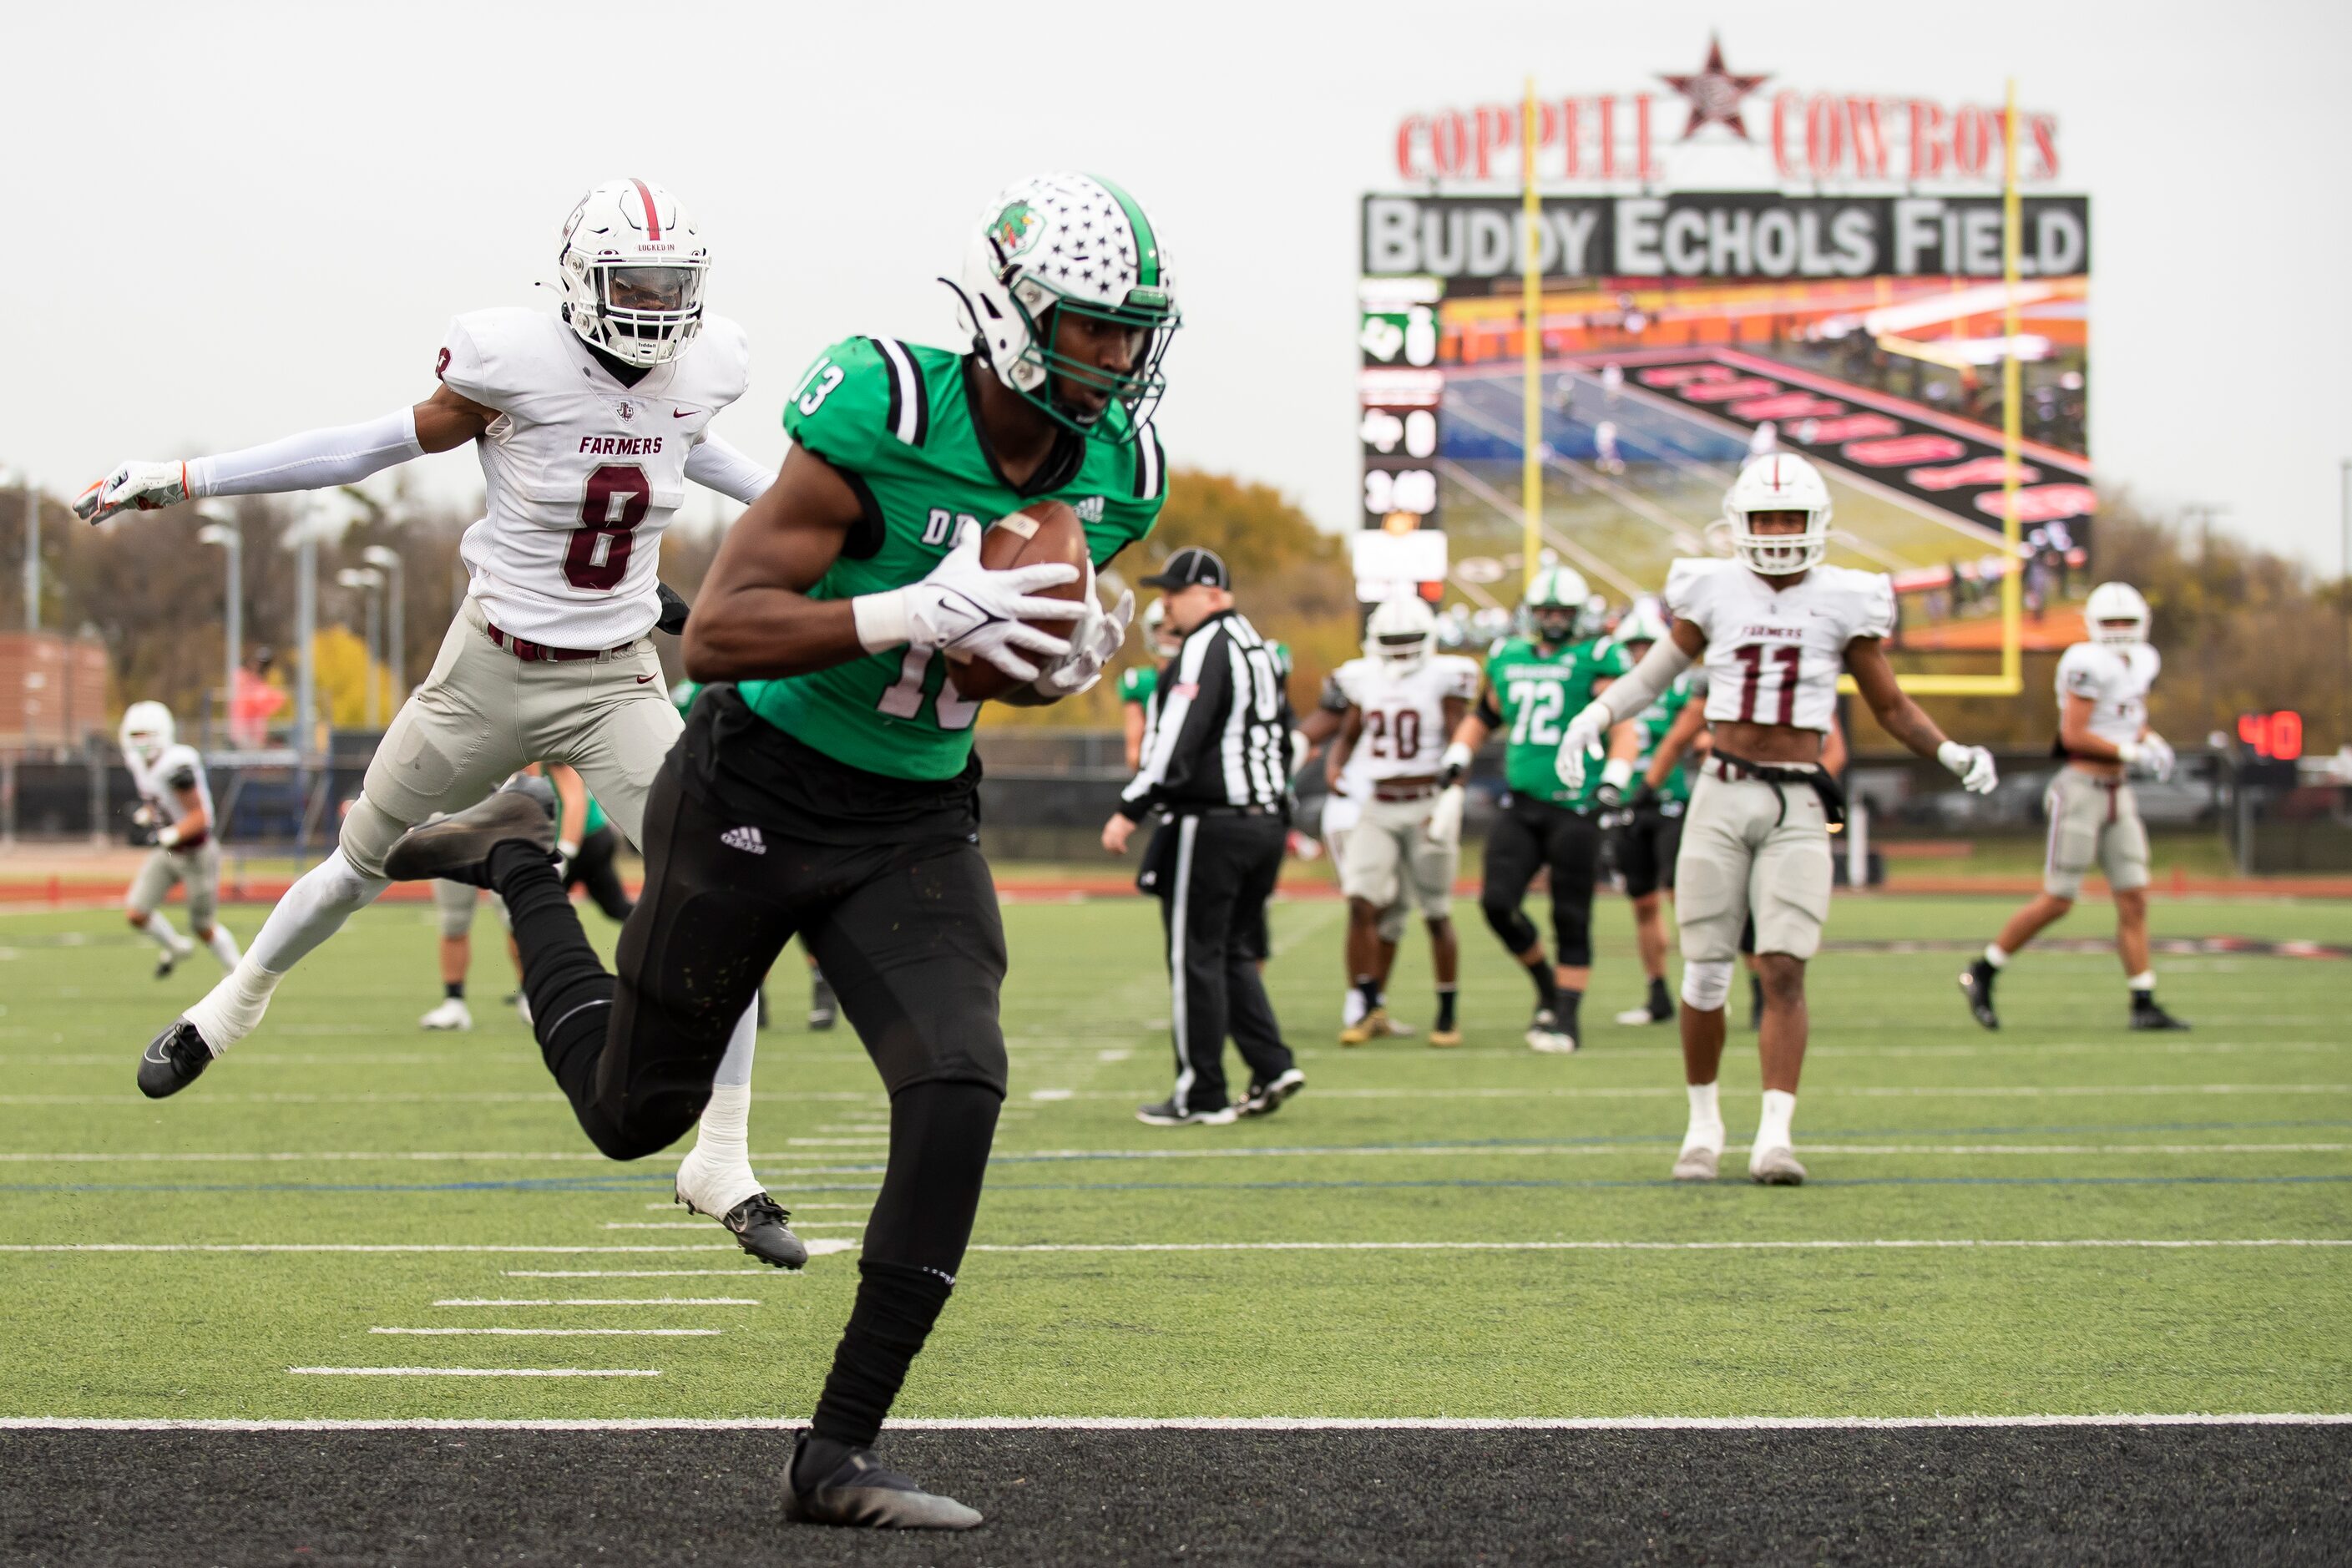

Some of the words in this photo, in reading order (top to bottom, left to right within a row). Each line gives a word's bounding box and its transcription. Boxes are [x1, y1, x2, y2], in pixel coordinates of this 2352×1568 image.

[1396, 93, 1664, 182] COPPELL
[1771, 90, 2060, 182] COWBOYS
[1366, 200, 1598, 277] BUDDY
[1615, 199, 1875, 277] ECHOLS
[1895, 200, 2085, 275] FIELD
[790, 356, 845, 417] 13
[579, 437, 663, 455] FARMERS
[559, 462, 654, 595] 8
[1741, 626, 1803, 640] FARMERS
[1508, 680, 1565, 746] 72
[1733, 644, 1803, 724] 11
[1364, 710, 1420, 760] 20
[2238, 711, 2303, 760] 40
